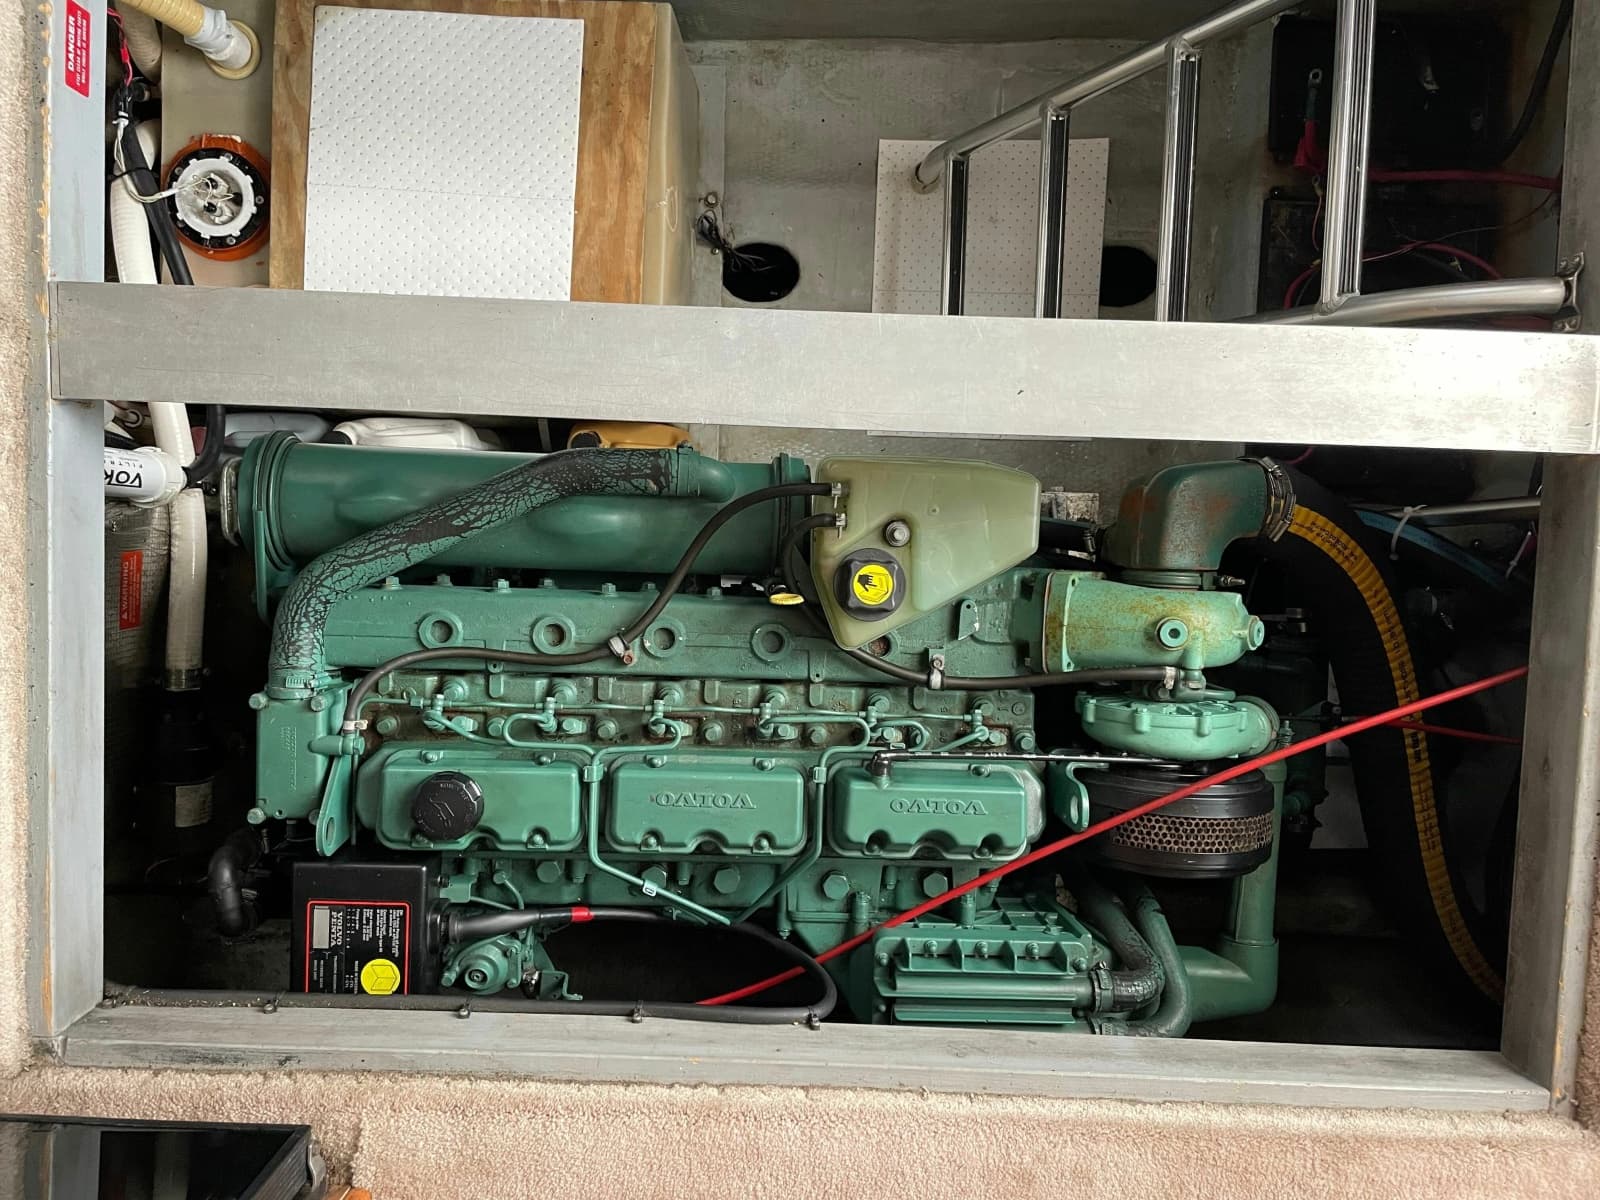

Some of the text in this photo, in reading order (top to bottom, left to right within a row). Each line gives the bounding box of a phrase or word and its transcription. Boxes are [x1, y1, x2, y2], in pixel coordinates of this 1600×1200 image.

[67, 15, 75, 72] DANGER
[121, 561, 129, 610] WARNING
[655, 791, 757, 810] VOLVO
[889, 798, 989, 816] VOLVO
